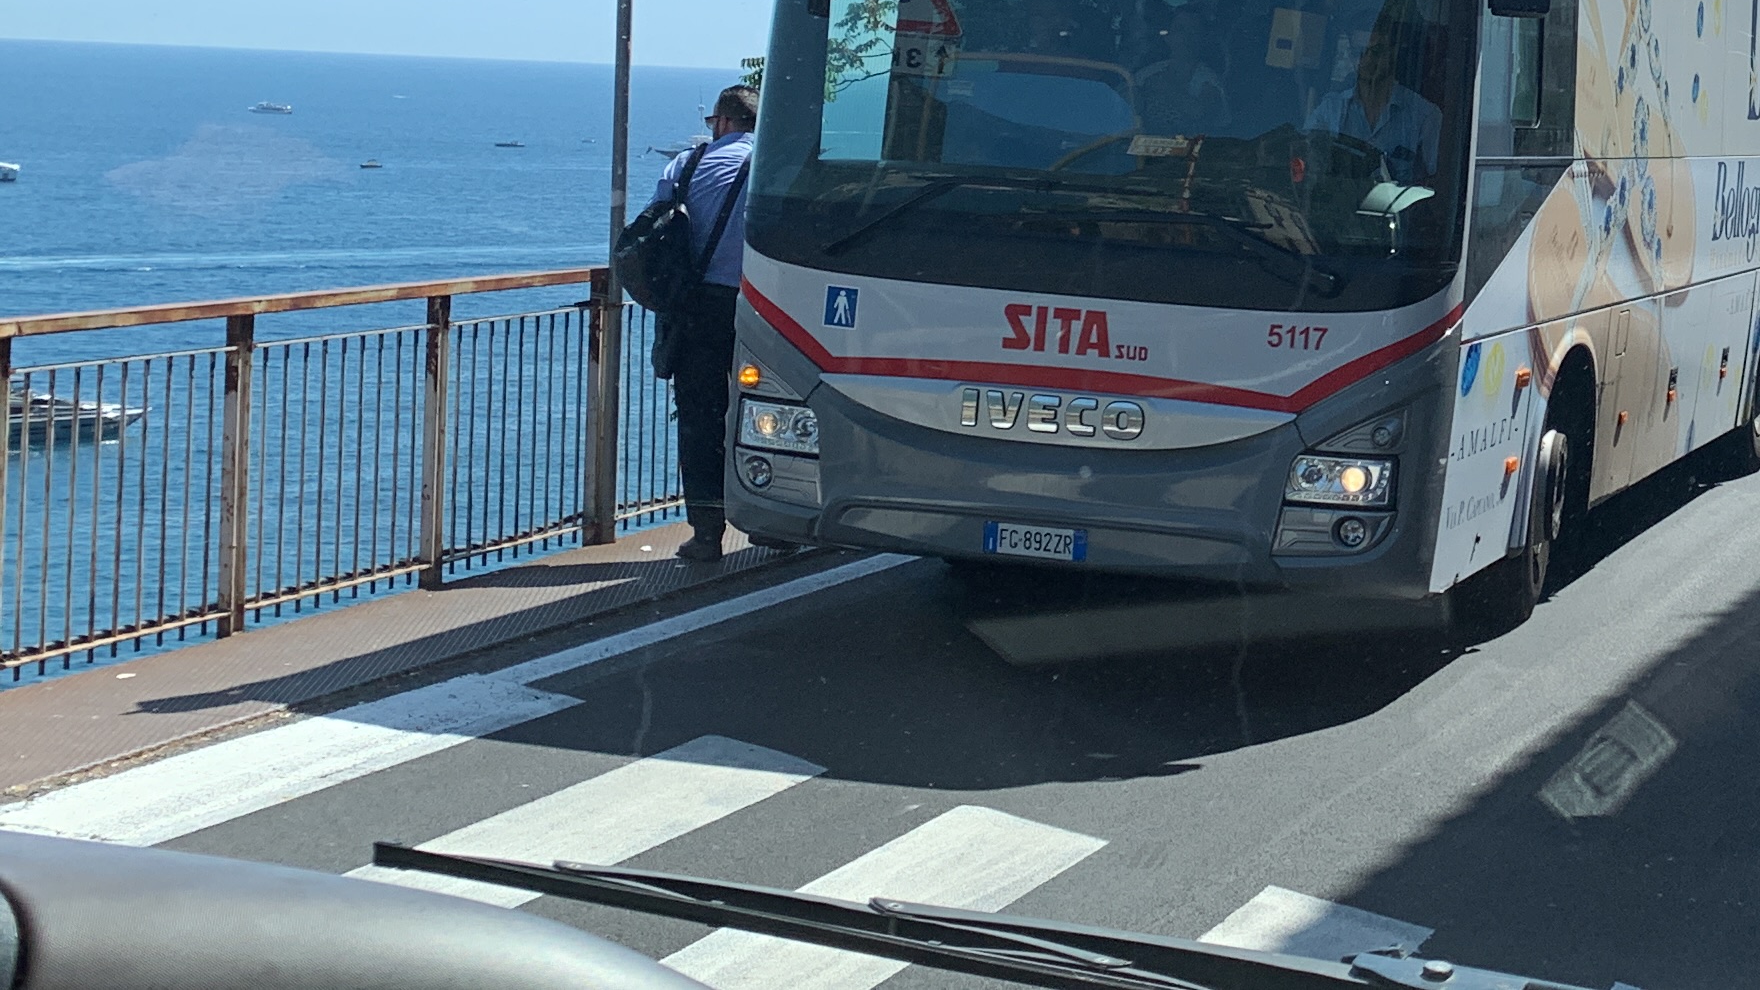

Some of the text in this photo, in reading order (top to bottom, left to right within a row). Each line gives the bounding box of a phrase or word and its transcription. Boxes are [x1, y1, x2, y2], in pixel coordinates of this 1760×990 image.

[1001, 303, 1149, 361] SITA SUD
[1267, 323, 1329, 351] 5117
[960, 387, 1146, 441] IVECO
